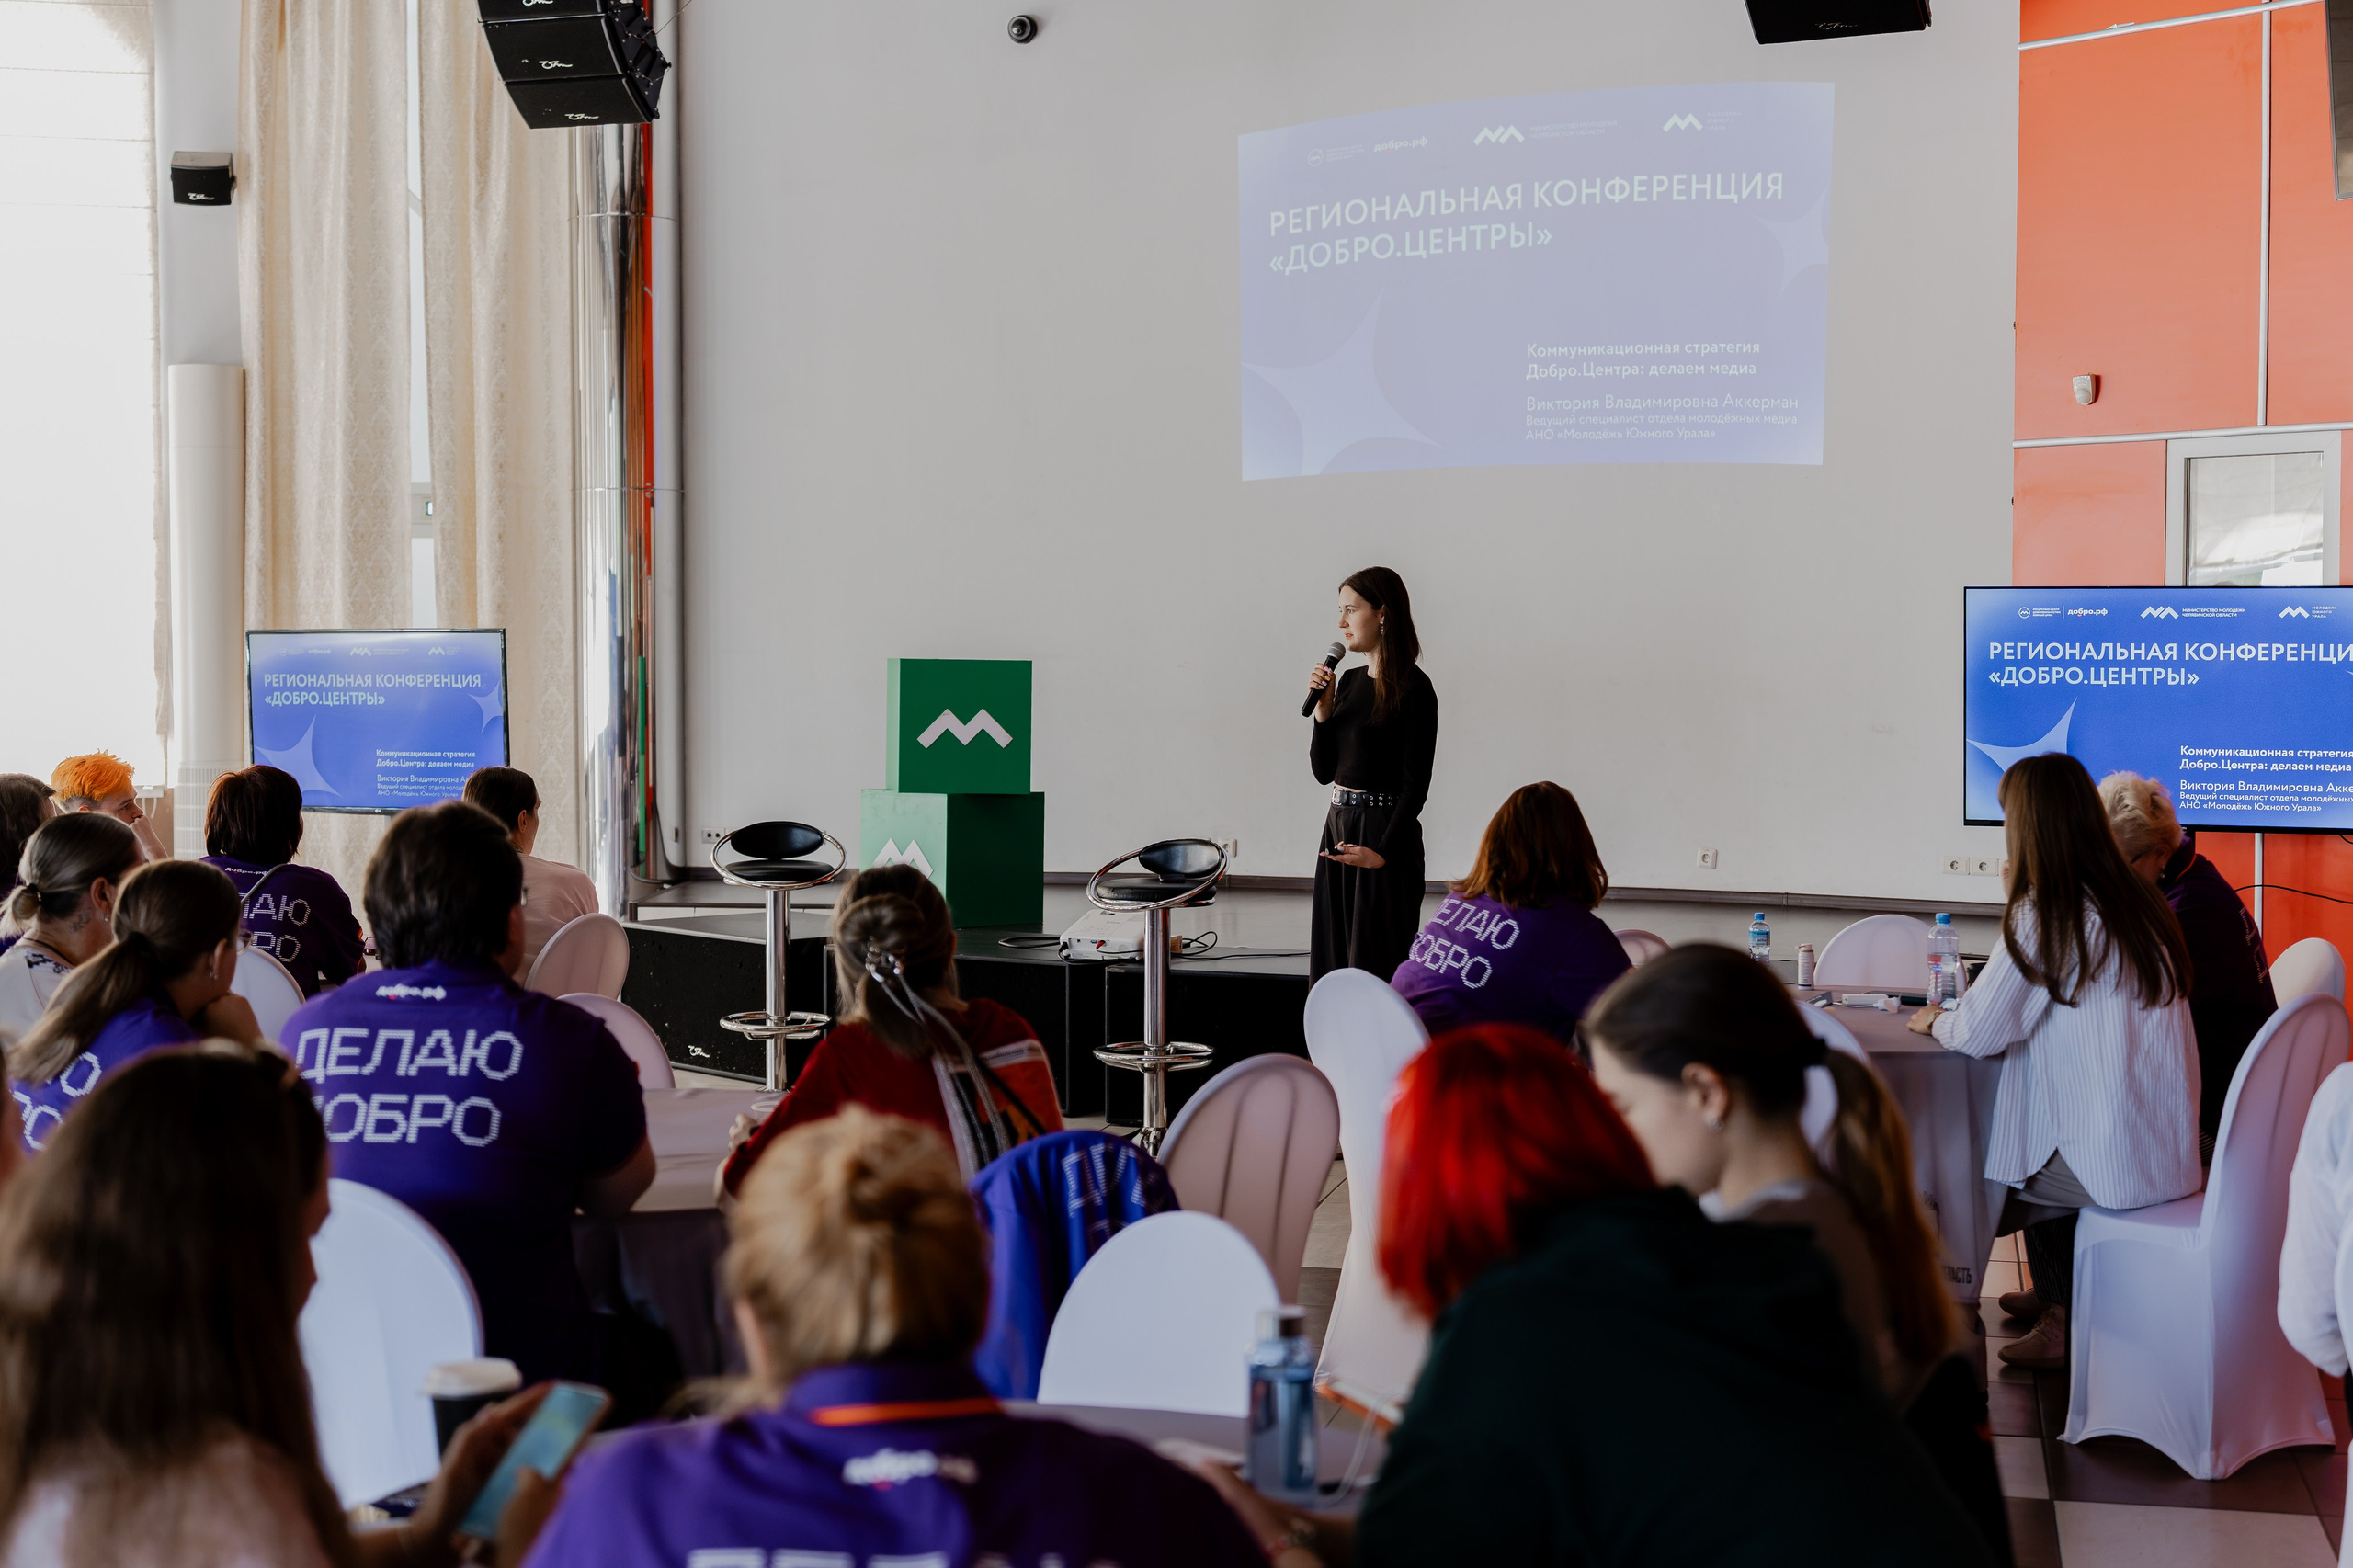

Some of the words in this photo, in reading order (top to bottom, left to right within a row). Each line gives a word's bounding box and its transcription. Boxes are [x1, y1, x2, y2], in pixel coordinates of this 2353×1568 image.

[1373, 135, 1428, 153] добро.рф
[1270, 183, 1522, 237] РЕГИОНАЛЬНАЯ
[1534, 172, 1783, 208] КОНФЕРЕНЦИЯ
[1269, 221, 1552, 276] «ДОБРО.ЦЕНТРЫ»
[1527, 342, 1680, 358] Коммуникационная
[1684, 343, 1760, 359] стратегия
[1526, 362, 1644, 380] Добро.Центра:
[1649, 362, 1705, 377] делаем
[1710, 362, 1756, 377] медиа
[1527, 396, 1599, 412] Виктория
[1605, 393, 1719, 412] Владимировна
[1722, 393, 1799, 412] Аккерман
[1526, 414, 1575, 427] Ведущий
[1579, 415, 1644, 425] специалист
[1647, 414, 1686, 425] отдела
[1688, 413, 1761, 425] молодёжных
[1763, 415, 1798, 425] медиа
[1526, 428, 1554, 440] АНО
[1626, 427, 1674, 439] Южного
[1677, 427, 1717, 439] Урала»
[2067, 608, 2109, 616] добро.рф
[1989, 642, 2177, 661] РЕГИОНАЛЬНАЯ
[2185, 642, 2353, 664] КОНФЕРЕНЦИ
[264, 674, 372, 687] РЕГИОНАЛЬНАЯ
[375, 674, 482, 689] КОНФЕРЕНЦИЯ
[1988, 666, 2200, 687] «ДОБРО.ЦЕНТРЫ»
[264, 691, 386, 707] «ДОБРО.ЦЕНТРЫ»
[376, 749, 441, 759] Коммуникационная
[442, 751, 476, 759] стратегия
[2180, 745, 2294, 758] Коммуникационная
[2297, 749, 2353, 758] стратегия
[376, 758, 426, 768] Добро.Центра:
[2179, 759, 2268, 772] Добро.Центра:
[2270, 763, 2313, 771] делаем
[2315, 764, 2352, 772] медиа
[377, 774, 408, 783] Виктория
[410, 774, 459, 784] Владимировна
[2180, 779, 2234, 792] Виктория
[2238, 780, 2323, 793] Владимировна
[2180, 791, 2217, 801] Ведущий
[2219, 794, 2268, 802] специалист
[2270, 794, 2299, 802] отдела
[2179, 801, 2201, 810] АНО
[2203, 802, 2252, 812] «Молодёжь
[2254, 803, 2290, 812] Южного
[2291, 803, 2321, 812] Урала»
[1426, 898, 1520, 950] ЕЛАЮ
[295, 1028, 524, 1084] ДЕЛАЮ
[312, 1093, 502, 1147] ОБРО
